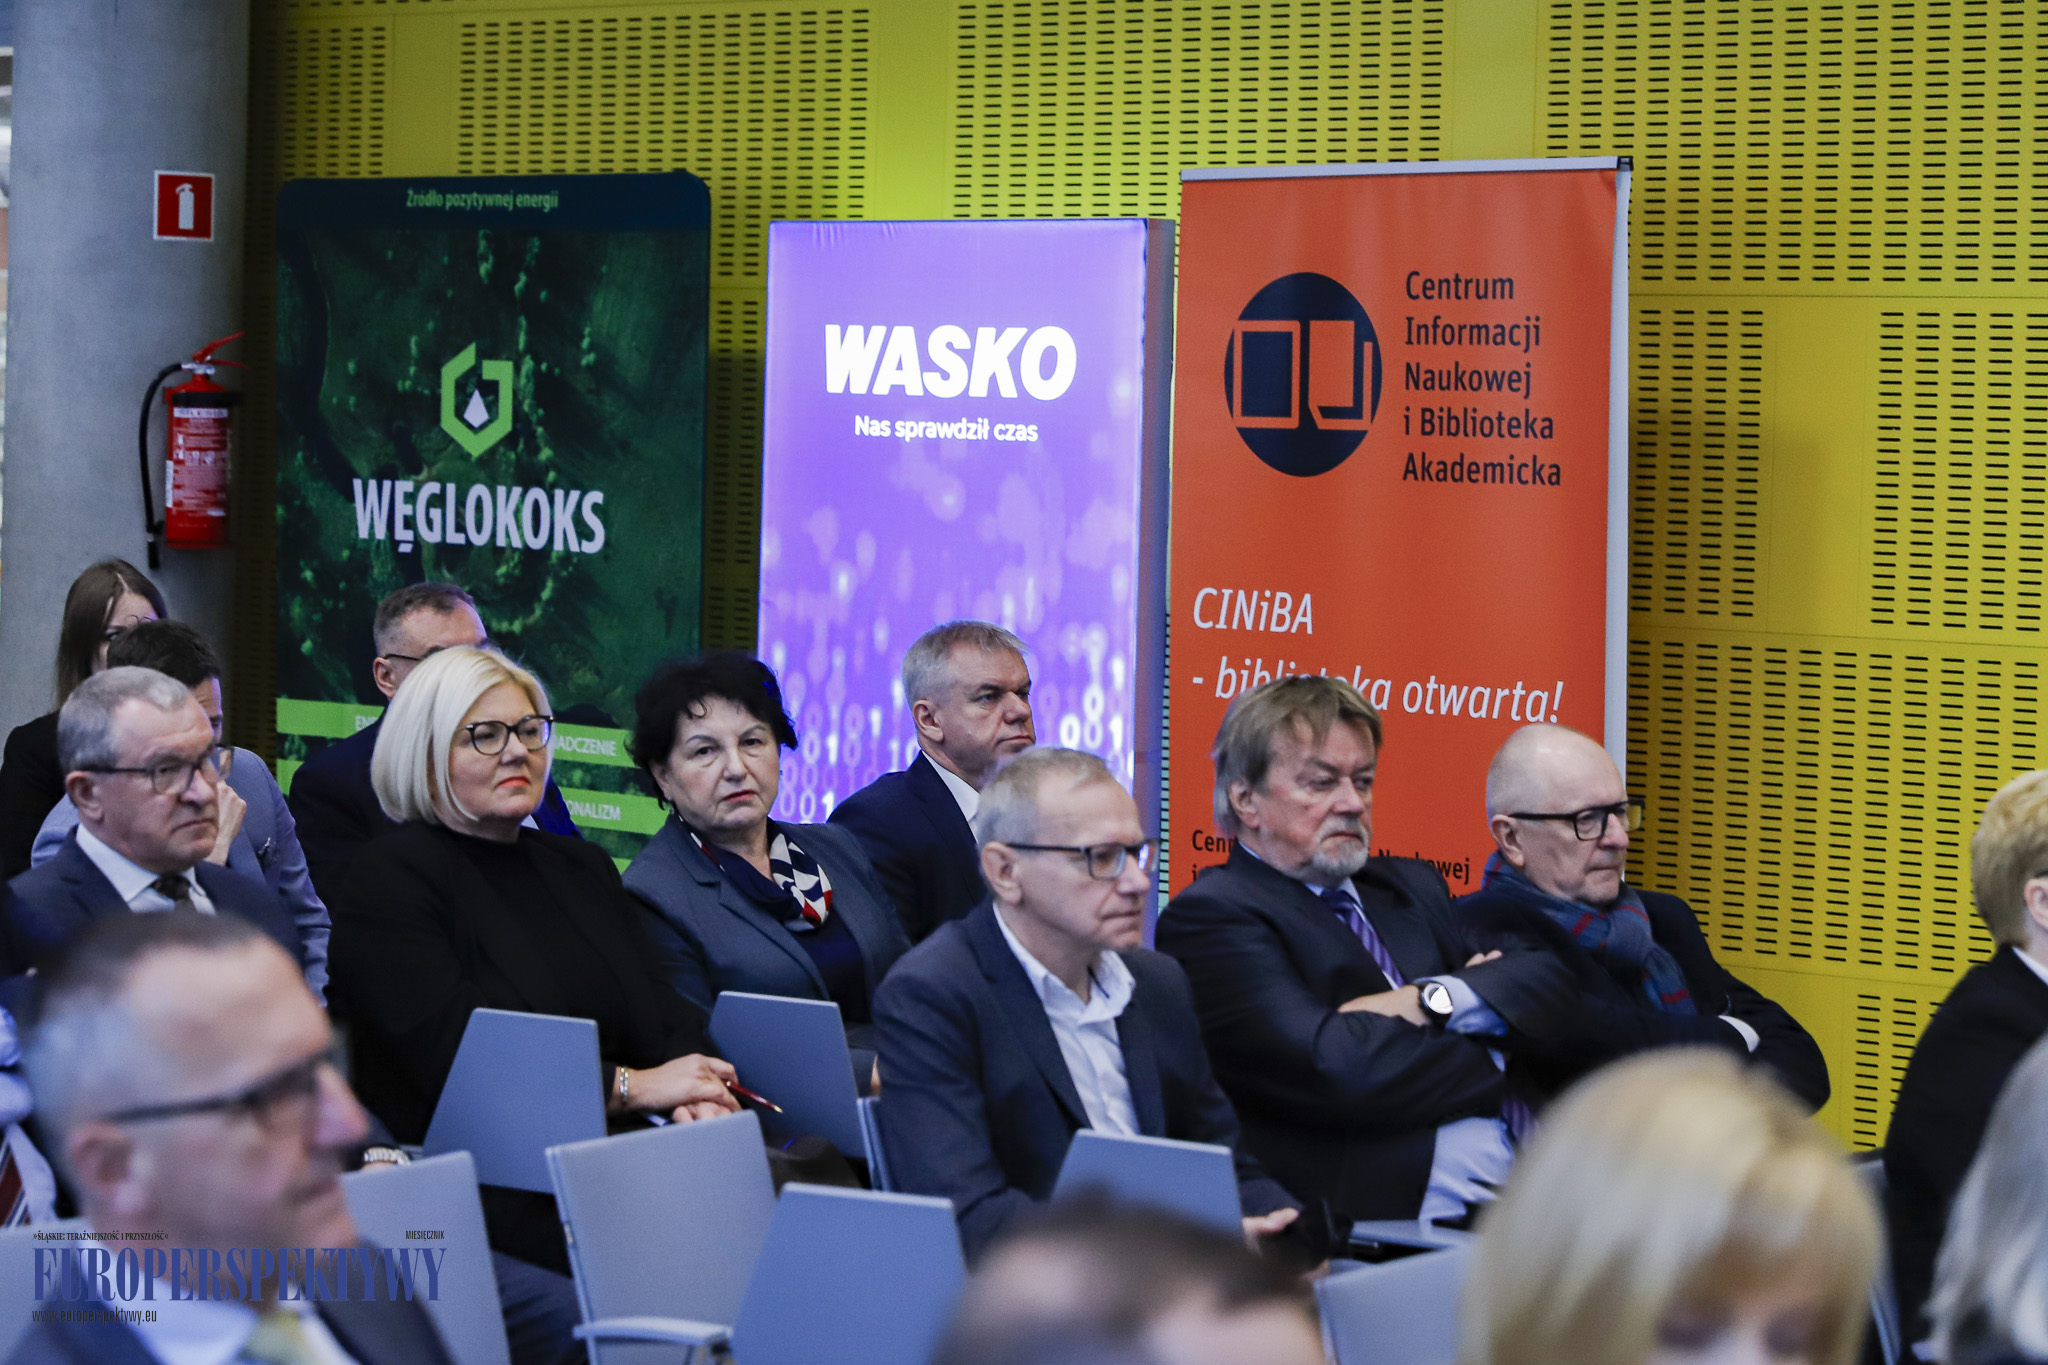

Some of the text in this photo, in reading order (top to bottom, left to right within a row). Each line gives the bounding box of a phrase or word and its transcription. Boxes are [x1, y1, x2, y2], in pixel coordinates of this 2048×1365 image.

[445, 189, 514, 211] pozytywnej
[516, 190, 559, 212] energii
[1405, 270, 1514, 300] Centrum
[1405, 315, 1541, 353] Informacji
[825, 324, 1077, 400] WASKO
[1404, 361, 1532, 399] Naukowej
[854, 415, 1039, 442] Nas sprawdził czas
[1403, 406, 1554, 439] i Biblioteka
[1402, 452, 1561, 486] Akademicka
[352, 478, 606, 553] WĘGLOKOKS
[1193, 587, 1314, 634] CINiBA
[1402, 675, 1564, 723] otwarta!
